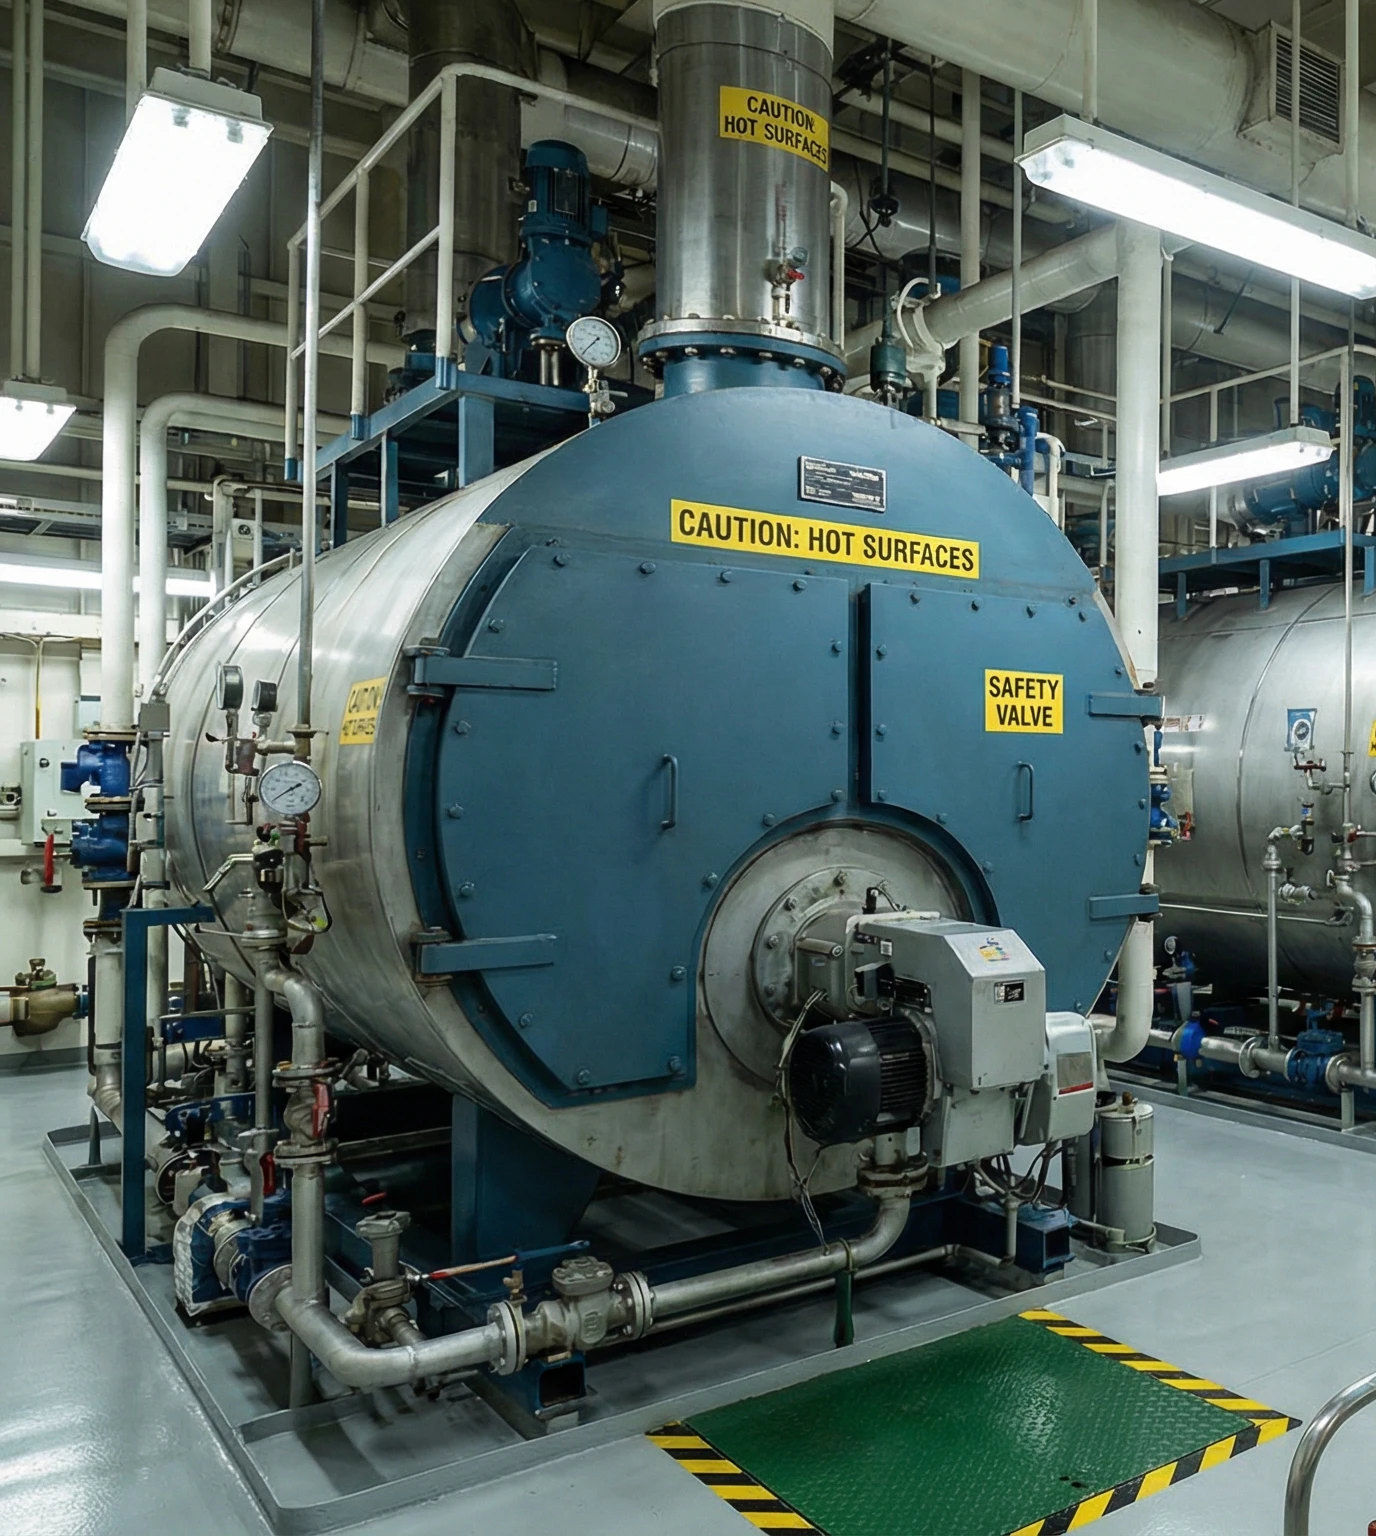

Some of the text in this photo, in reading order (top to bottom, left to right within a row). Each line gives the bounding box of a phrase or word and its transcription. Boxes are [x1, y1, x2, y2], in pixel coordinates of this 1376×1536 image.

[724, 115, 758, 136] HOT
[679, 508, 974, 572] CAUTION: HOT SURFACES
[989, 675, 1059, 700] SAFETY
[996, 703, 1053, 727] VALVE
